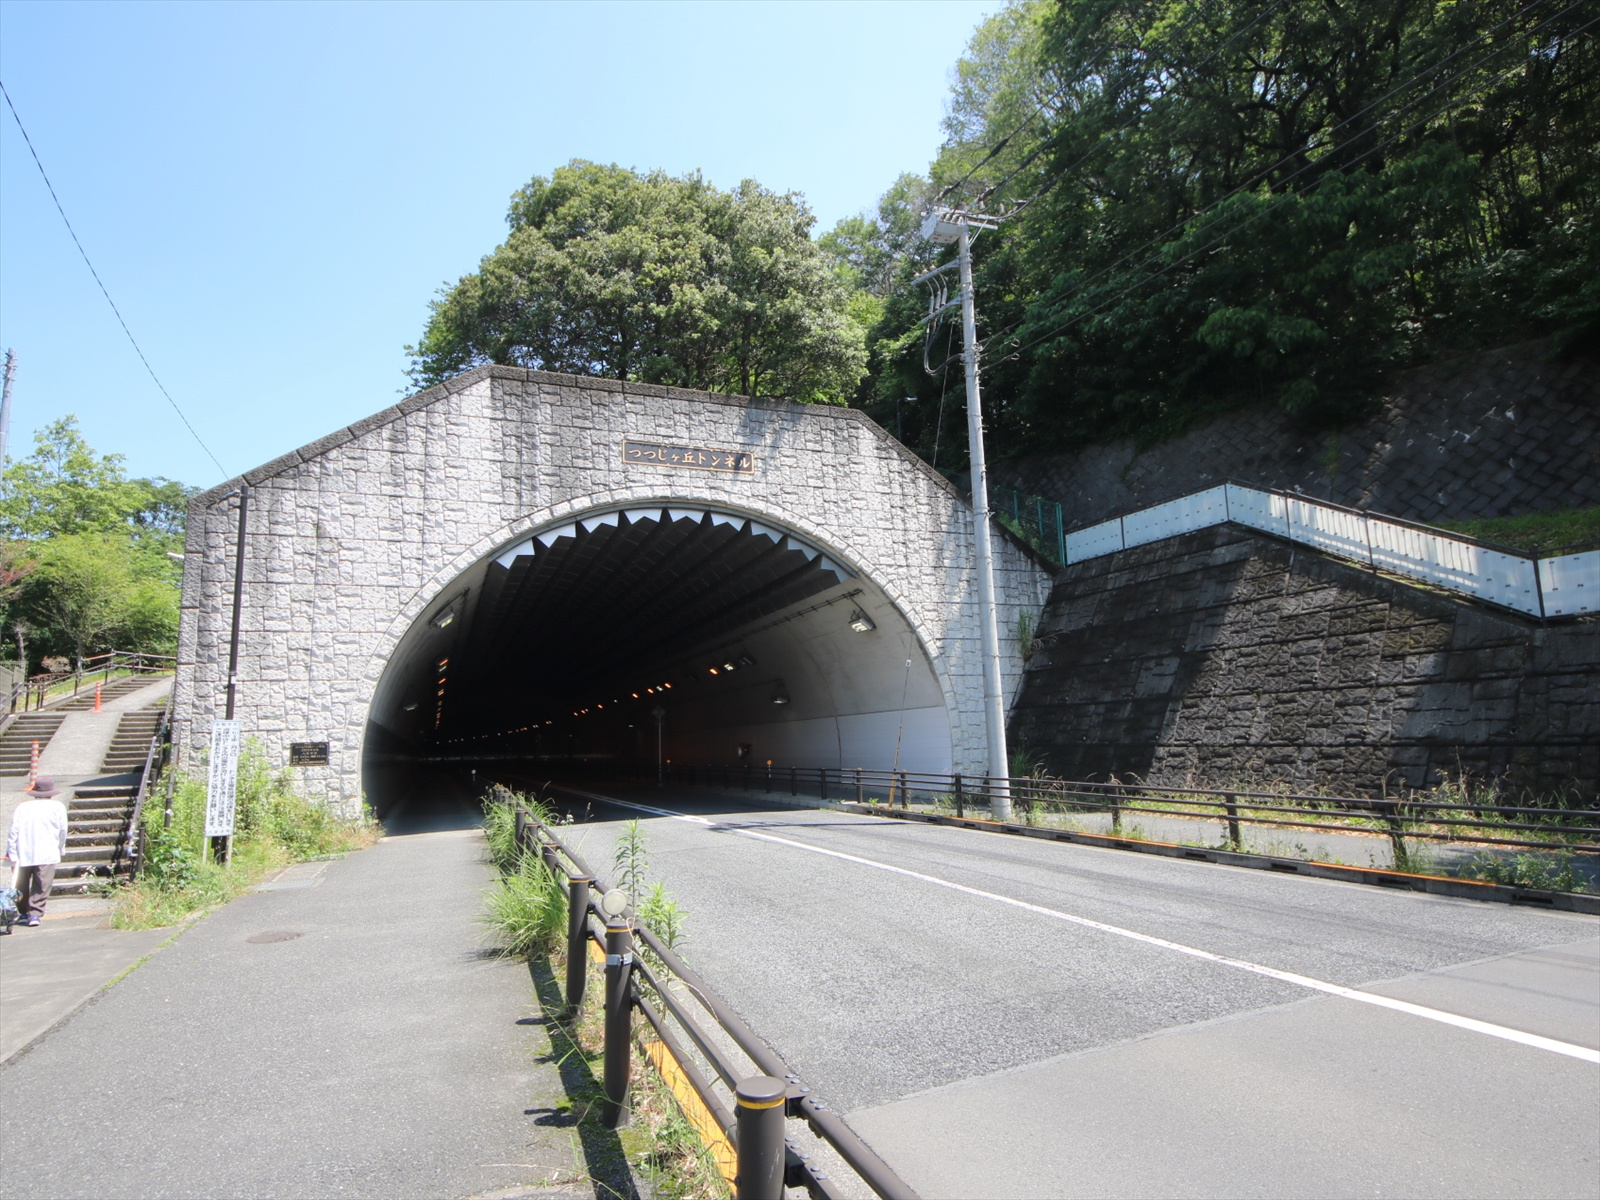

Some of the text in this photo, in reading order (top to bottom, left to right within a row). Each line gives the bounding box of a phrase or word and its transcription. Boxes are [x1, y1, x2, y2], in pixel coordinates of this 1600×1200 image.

[628, 448, 750, 468] つつじヶ丘トンネル
